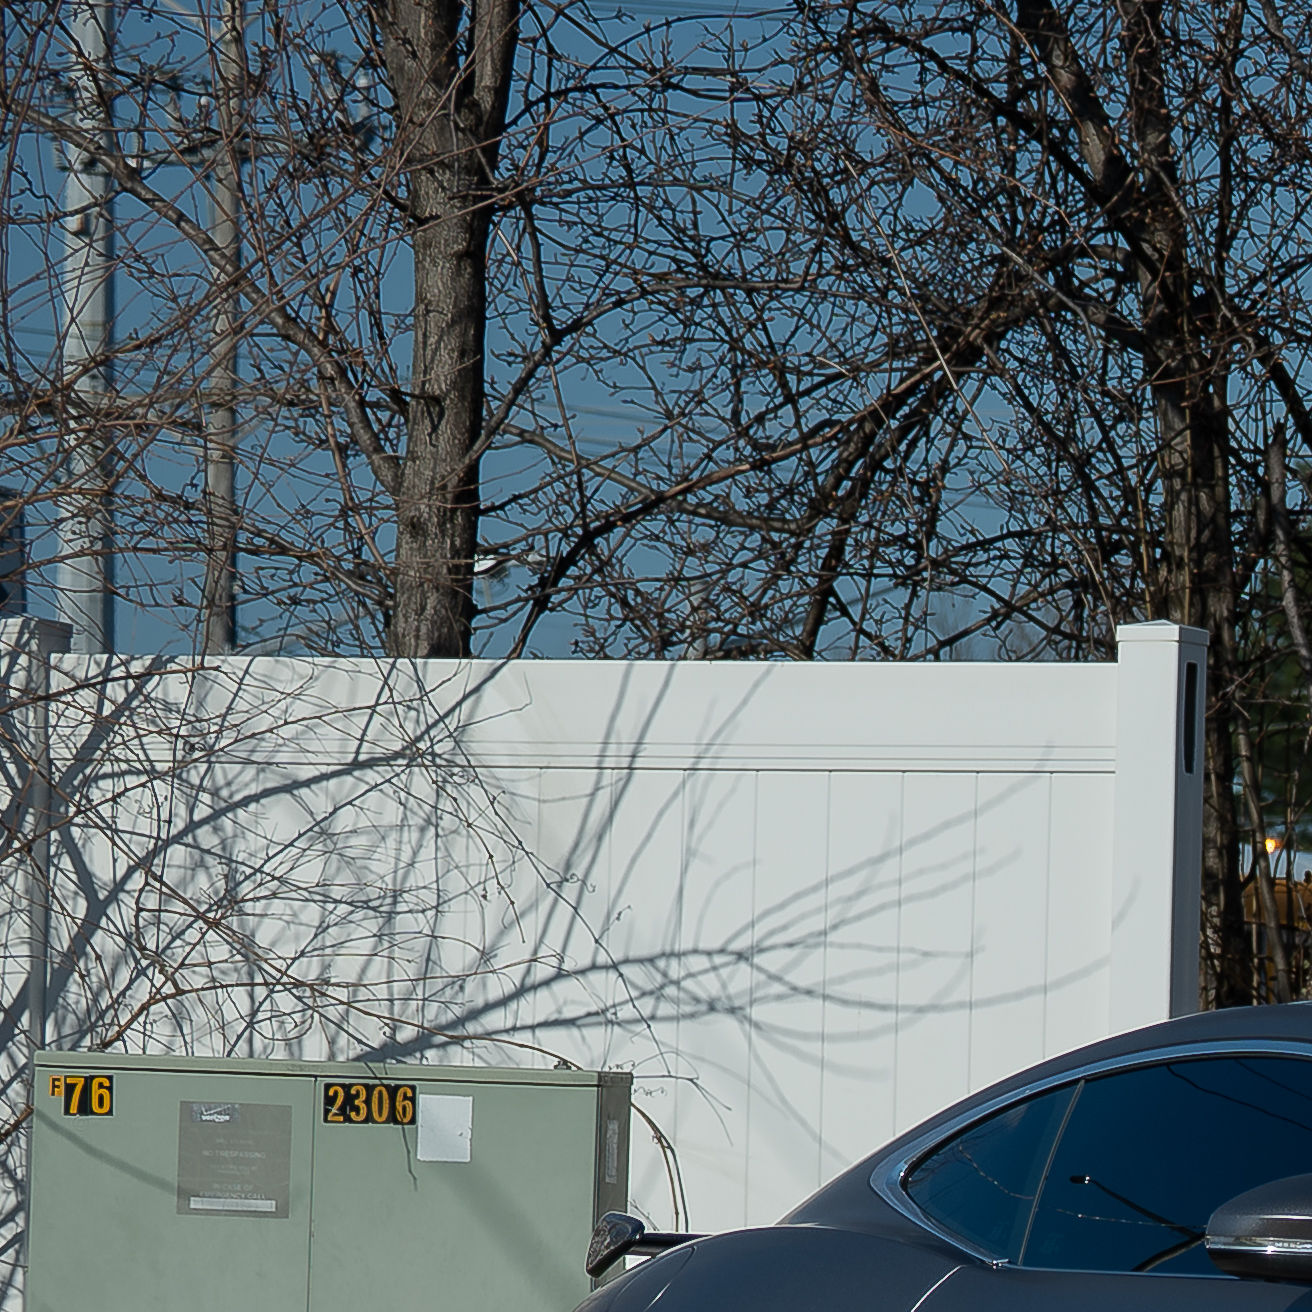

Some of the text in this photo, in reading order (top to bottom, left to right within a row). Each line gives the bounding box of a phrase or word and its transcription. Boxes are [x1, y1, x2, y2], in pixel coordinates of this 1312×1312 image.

[51, 1077, 111, 1114] F 76
[327, 1085, 413, 1123] 2306
